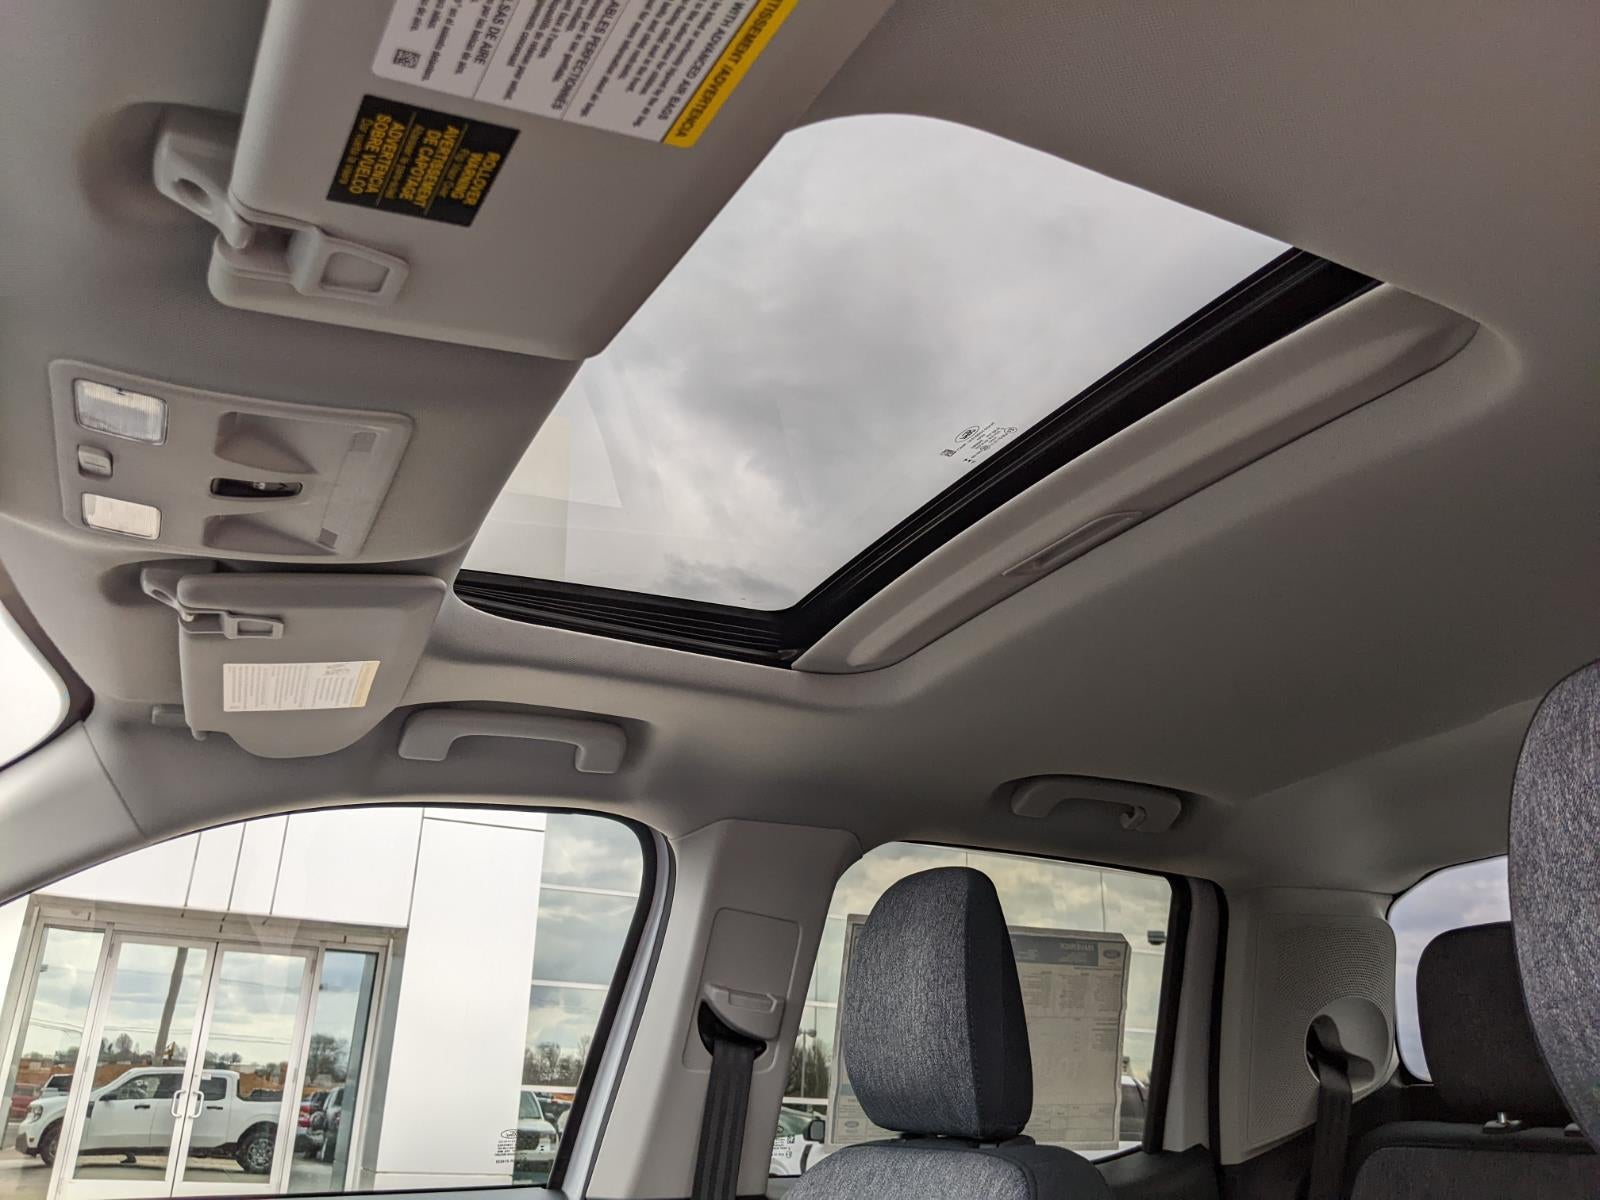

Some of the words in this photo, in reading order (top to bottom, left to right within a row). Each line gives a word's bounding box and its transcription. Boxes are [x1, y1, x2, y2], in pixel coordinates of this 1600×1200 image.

[484, 25, 500, 40] DE
[593, 0, 620, 34] ABLES
[720, 1, 745, 27] WITH
[731, 0, 782, 64] TISSEMENT
[473, 40, 492, 65] AIRE
[685, 26, 726, 79] ADVANCED
[674, 78, 691, 96] AIR
[657, 95, 680, 120] BAGS
[364, 114, 392, 152] SOBRE
[423, 129, 442, 146] DE
[348, 153, 376, 193] VUELCO
[364, 121, 405, 192] ADVERTENCIA
[399, 146, 434, 200] CAPOTAGE
[413, 125, 459, 207] AVERTISSEMENT
[450, 152, 483, 198] WARNING
[462, 151, 500, 205] ROLLOVER
